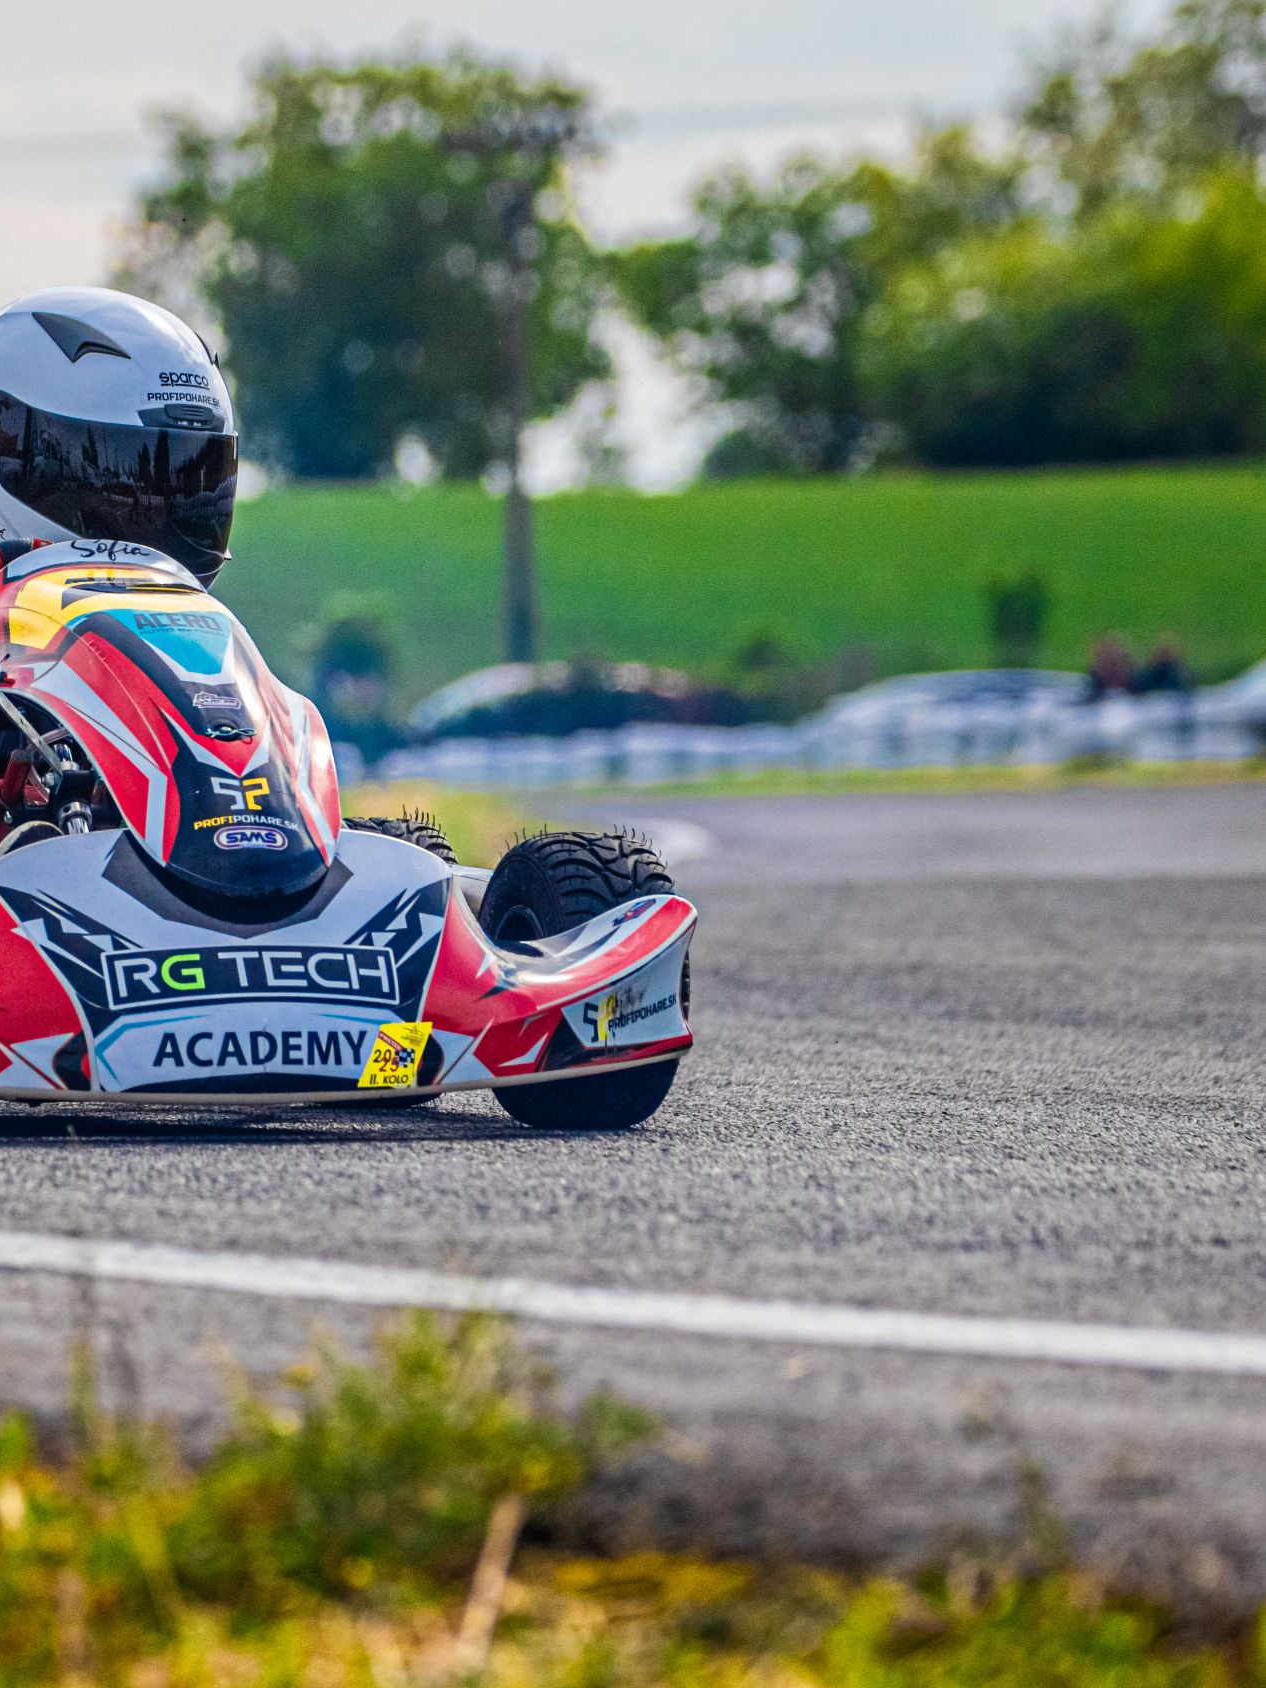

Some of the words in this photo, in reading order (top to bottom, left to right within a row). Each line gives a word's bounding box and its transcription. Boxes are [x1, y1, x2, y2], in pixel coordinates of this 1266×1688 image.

[159, 372, 209, 388] sparco
[70, 540, 150, 561] Sofia
[134, 613, 222, 633] ACERO
[114, 953, 206, 998] RG
[218, 951, 390, 993] TECH
[152, 1030, 367, 1067] ACADEMY
[383, 1074, 409, 1085] KOLO
